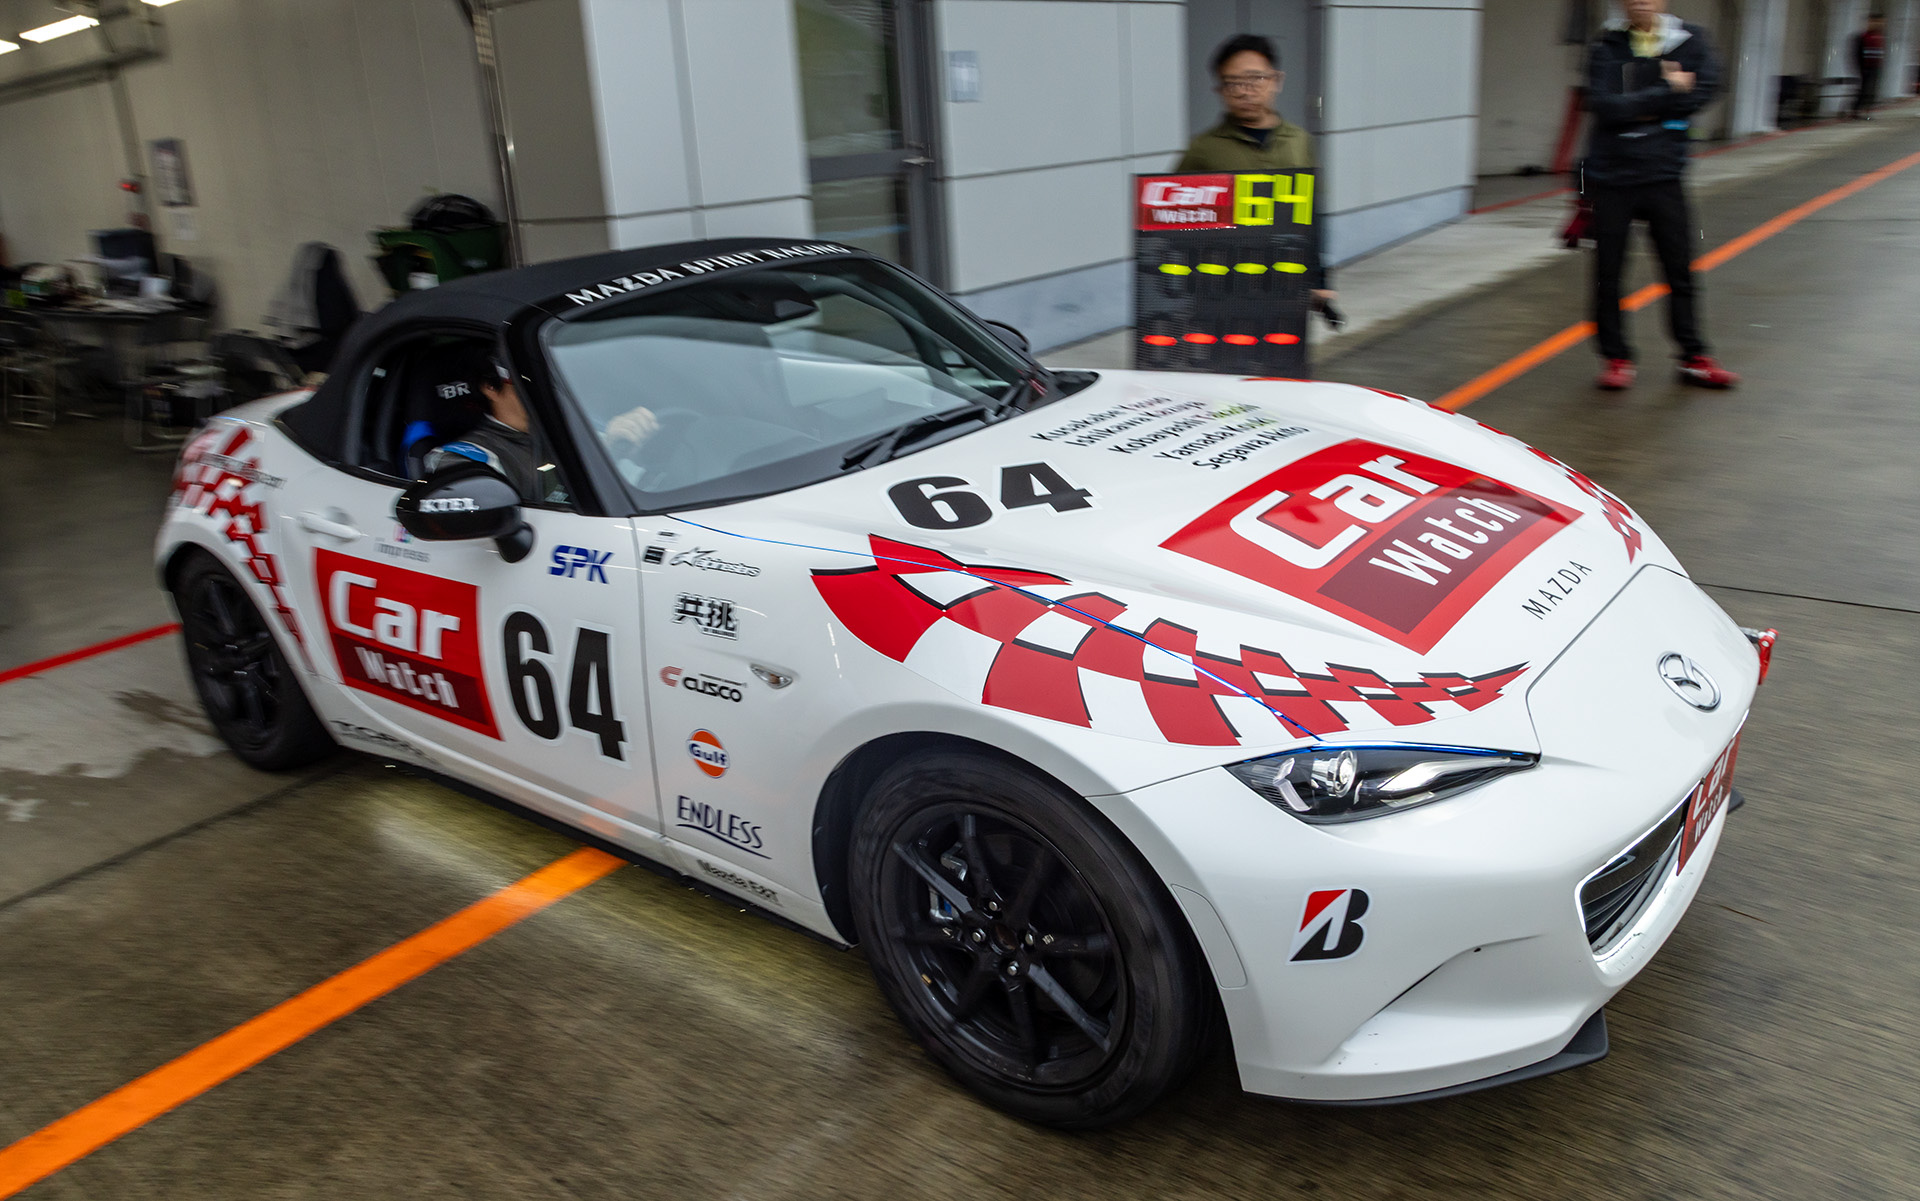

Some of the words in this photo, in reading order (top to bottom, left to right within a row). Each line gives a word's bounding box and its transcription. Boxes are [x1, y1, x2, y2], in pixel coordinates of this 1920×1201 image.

[1141, 182, 1228, 206] Car
[1233, 173, 1315, 226] 64
[1152, 207, 1218, 224] Watch
[565, 268, 685, 306] MAZDA
[680, 251, 765, 275] SPIRIT
[761, 244, 851, 259] RACING
[1064, 416, 1153, 447] Ishikawa
[1107, 417, 1207, 455] Kobayashi
[1153, 431, 1236, 460] Yamada
[1192, 438, 1272, 470] Segawa
[888, 461, 1094, 531] 64
[1229, 454, 1441, 570] Car
[547, 545, 614, 584] SPK
[1368, 494, 1522, 586] Watch
[328, 570, 460, 660] Car
[1521, 560, 1593, 620] MAZDA
[354, 646, 459, 709] Watch
[503, 611, 627, 762] 64
[689, 743, 728, 766] Gulf
[676, 794, 763, 850] ENDLESS
